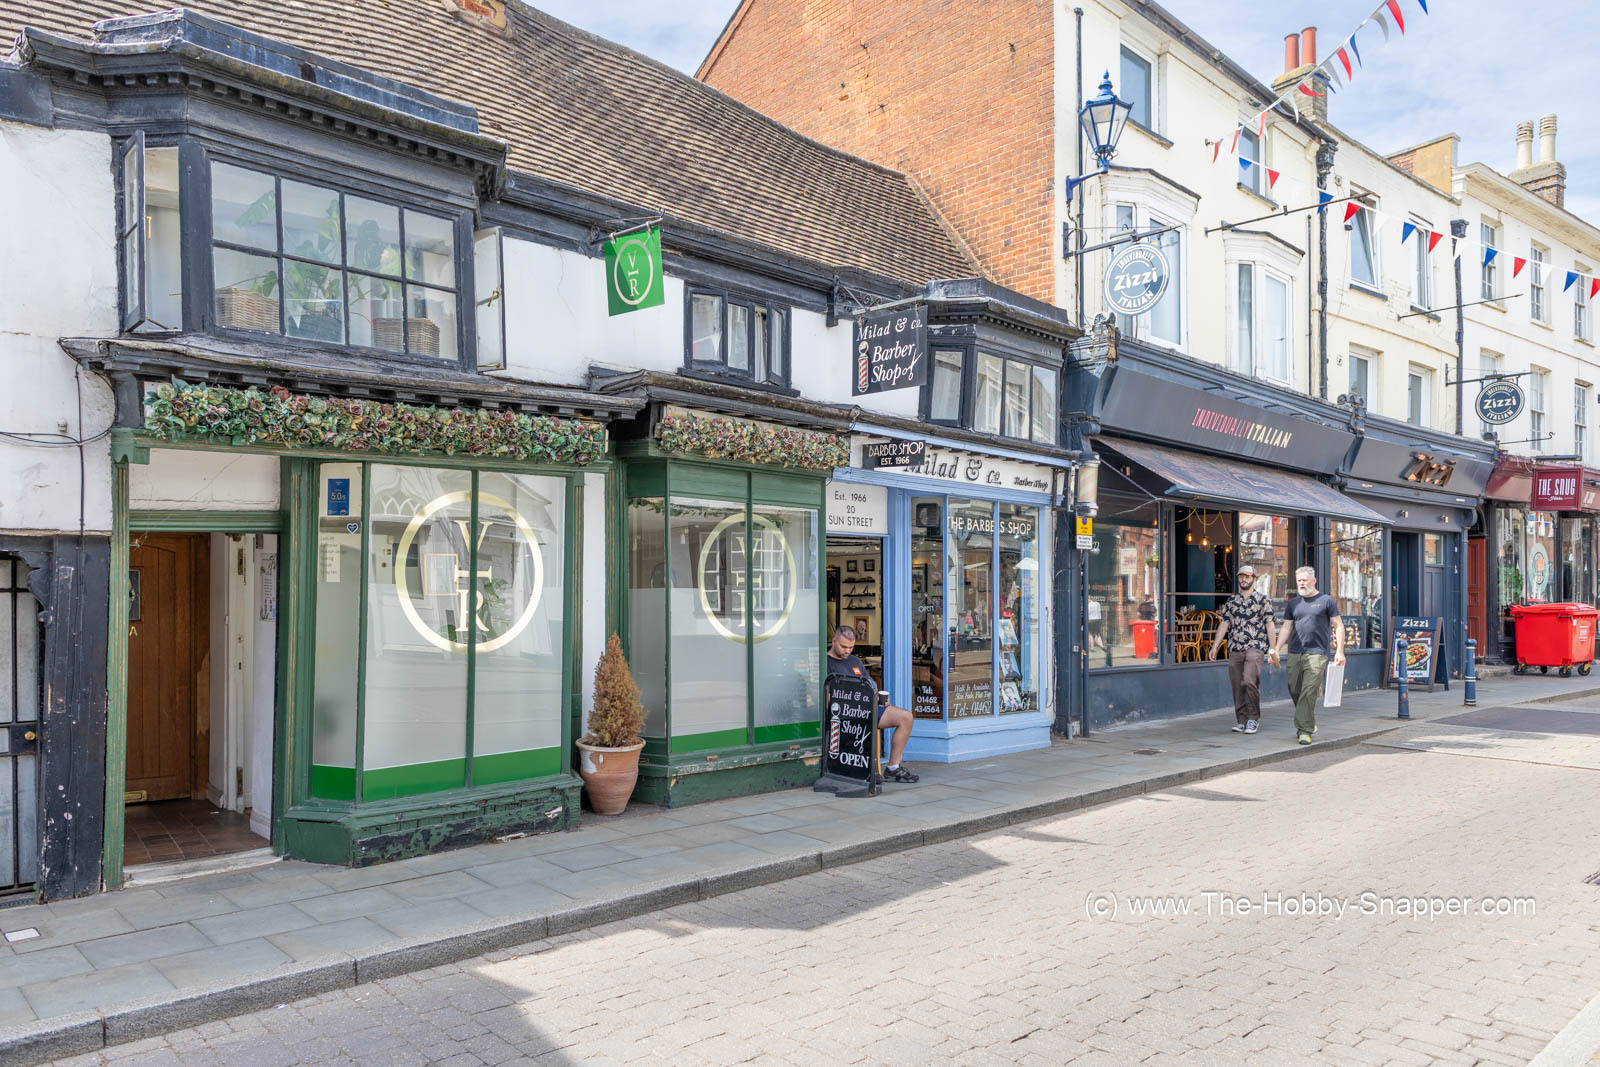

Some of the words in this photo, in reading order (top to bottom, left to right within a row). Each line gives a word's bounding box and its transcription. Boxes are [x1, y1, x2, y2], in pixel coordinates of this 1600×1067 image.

[1113, 267, 1158, 291] Zizzi
[1117, 290, 1154, 309] ITALIAN
[856, 320, 891, 341] Milad
[895, 317, 908, 333] &
[871, 340, 916, 363] Barber
[871, 363, 901, 386] Shop
[1483, 395, 1517, 410] Zizzi
[1486, 410, 1514, 420] ITALIAN
[868, 444, 898, 457] BARBER
[898, 441, 924, 456] SHOP
[880, 458, 893, 466] EST.
[895, 456, 910, 465] 1966
[966, 458, 982, 481] &
[1538, 479, 1552, 496] THE
[834, 490, 847, 501] Est.
[851, 493, 867, 503] 1966
[846, 505, 856, 514] 20
[828, 515, 845, 526] SUN
[847, 516, 874, 528] STREET
[966, 517, 1005, 534] BARBES
[1007, 521, 1032, 536] SHOP
[1402, 618, 1429, 628] Zizzi
[832, 689, 852, 700] Milad
[853, 691, 861, 701] &
[916, 695, 938, 704] 01462
[842, 703, 871, 719] Barber
[914, 704, 940, 713] 434564
[953, 702, 969, 717] Tel:
[841, 720, 862, 739] Shop
[840, 752, 870, 769] OPEN
